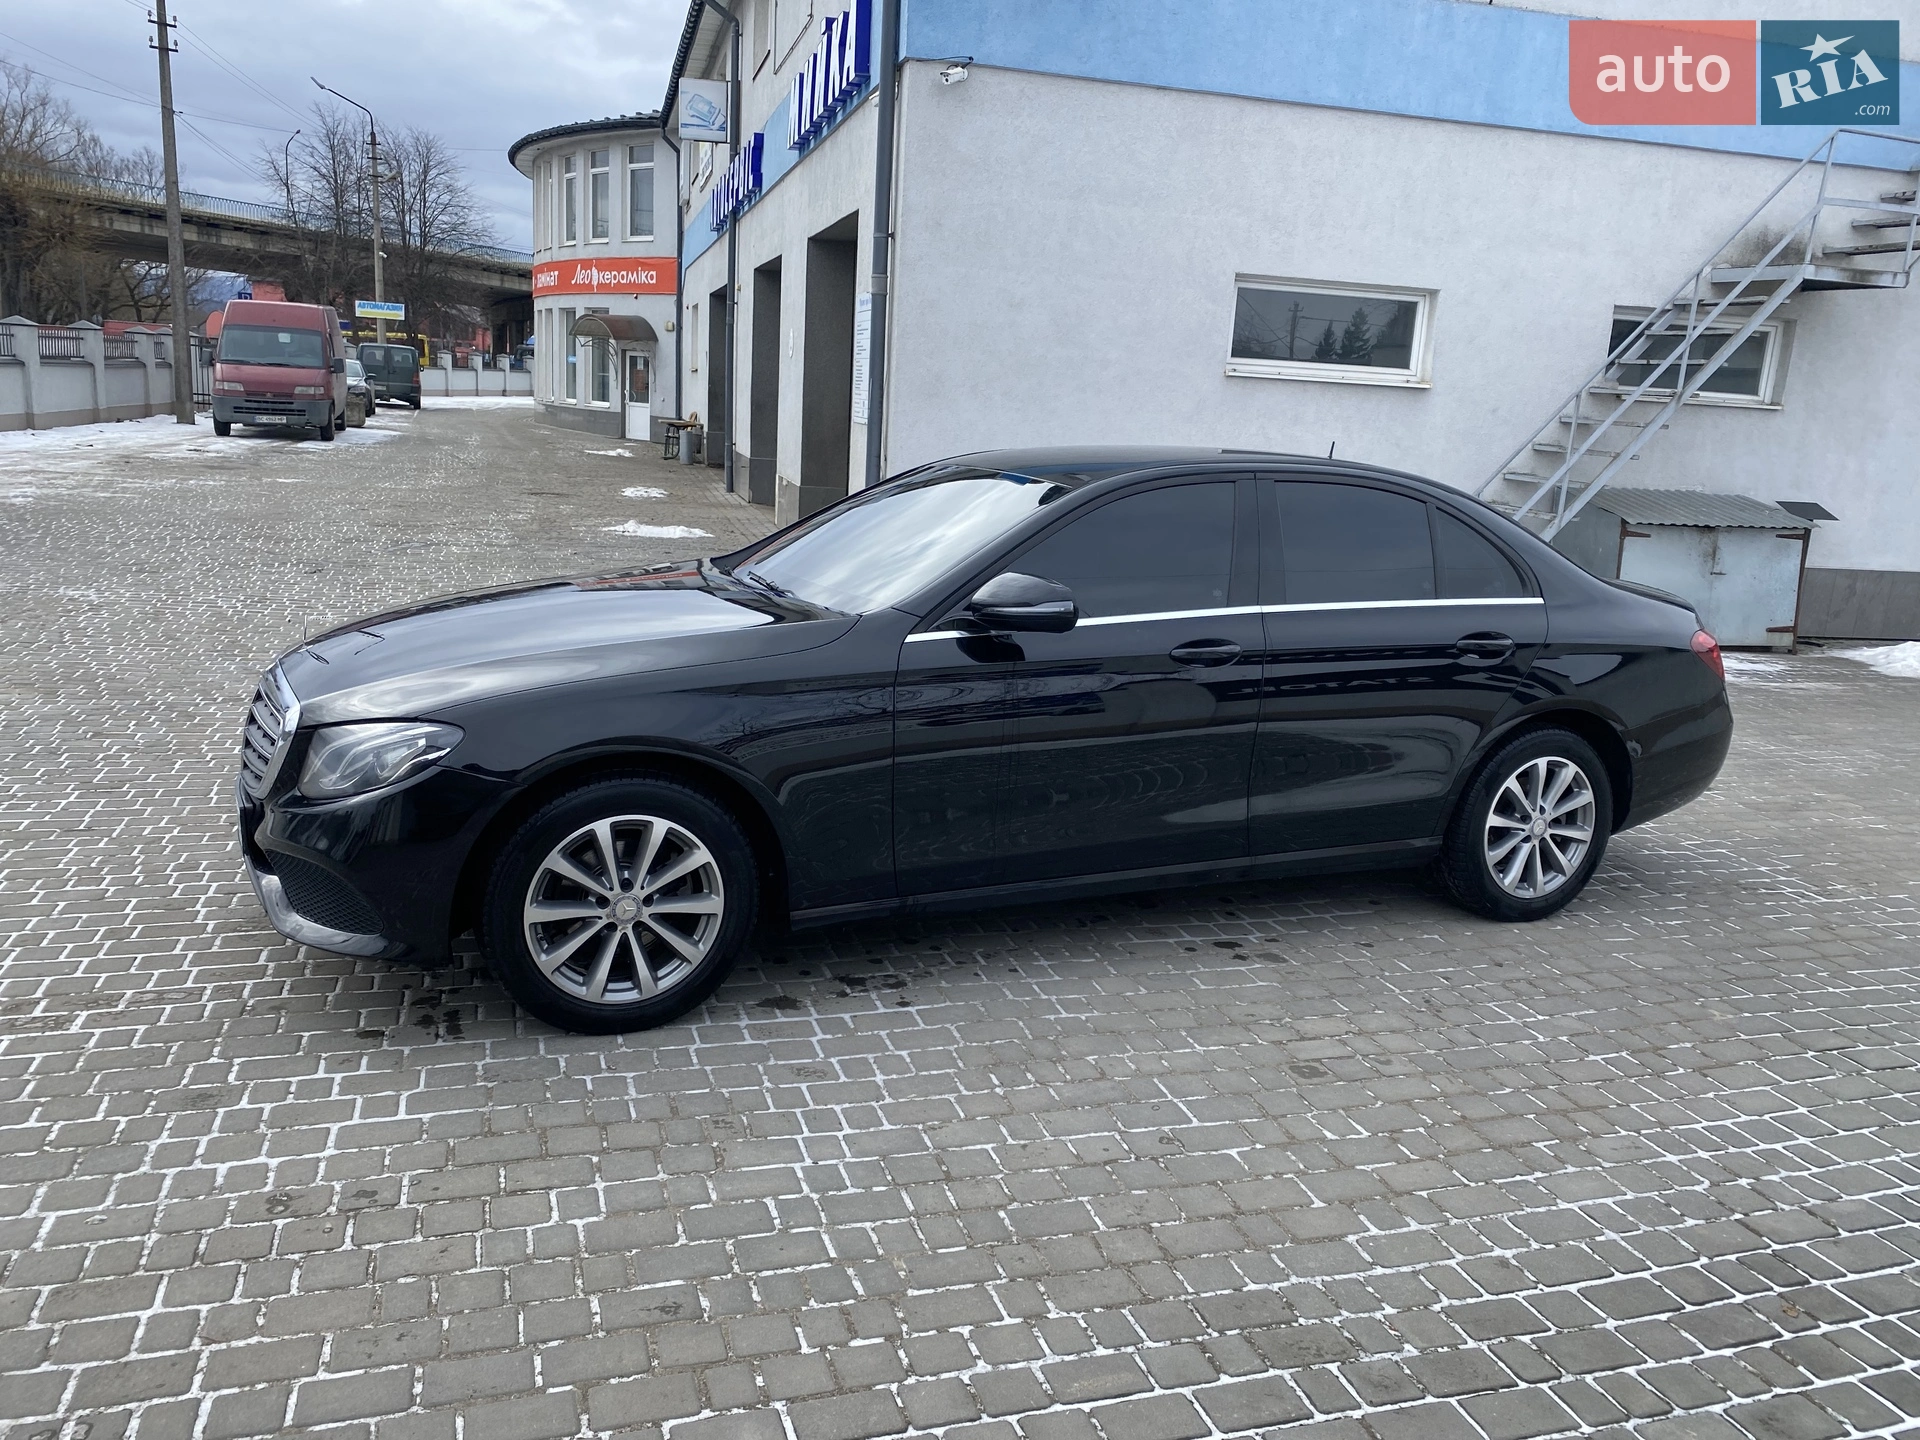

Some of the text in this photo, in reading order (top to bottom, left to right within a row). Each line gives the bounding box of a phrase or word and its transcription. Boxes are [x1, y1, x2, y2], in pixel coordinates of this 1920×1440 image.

[571, 263, 657, 287] Лео кераміка
[357, 302, 404, 312] АВТОМАГАЗИН
